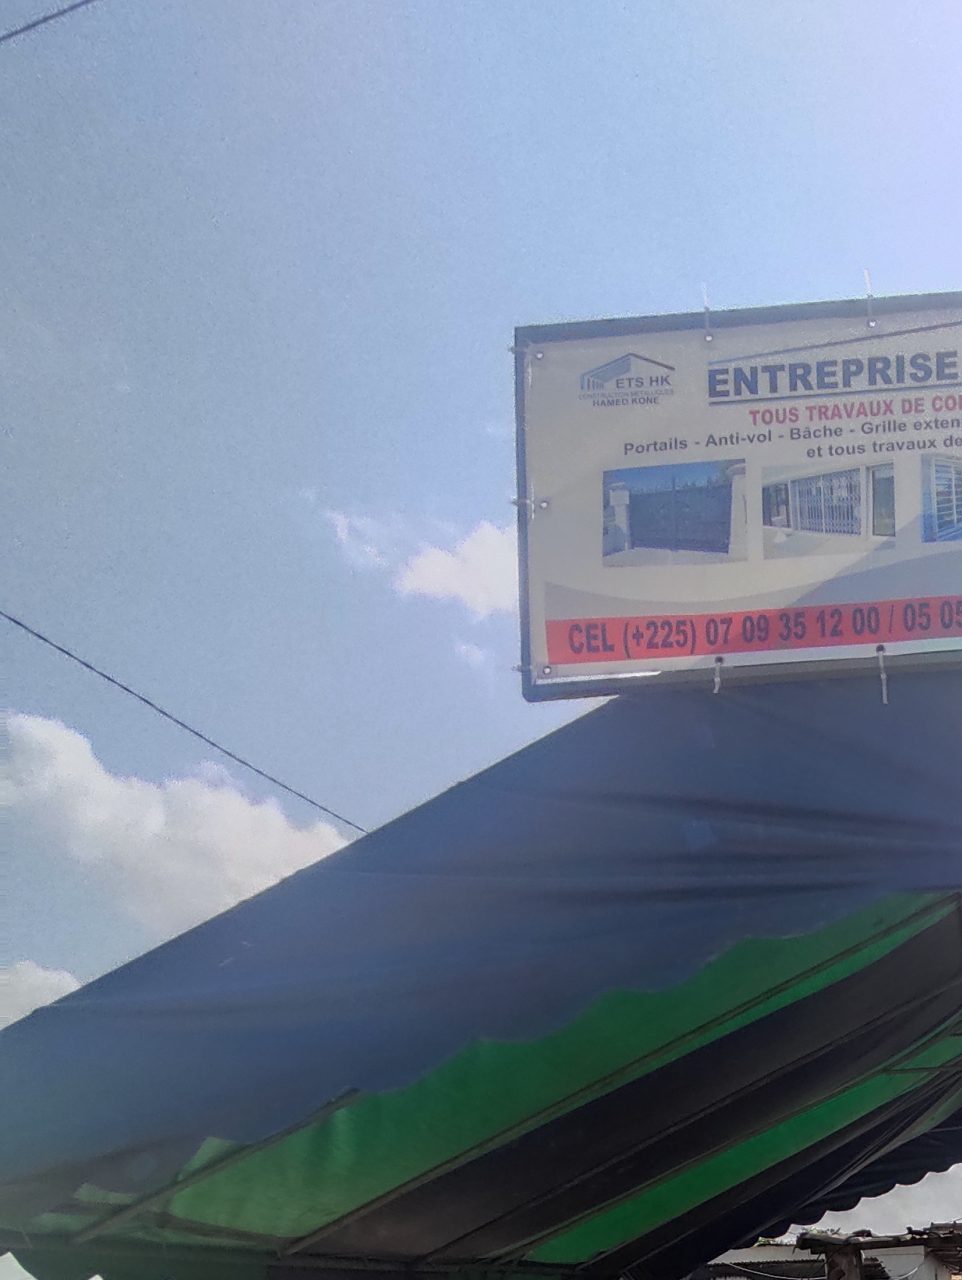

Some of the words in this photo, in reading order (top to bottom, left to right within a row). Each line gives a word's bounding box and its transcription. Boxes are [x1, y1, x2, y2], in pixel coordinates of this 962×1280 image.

[616, 377, 645, 389] ETS
[649, 375, 672, 387] HK
[708, 350, 959, 398] ENTREPRISE
[593, 398, 629, 406] HAMED
[631, 396, 660, 405] KONE
[749, 407, 799, 426] TOUS
[805, 399, 894, 422] TRAVAUX
[901, 396, 925, 415] DE
[623, 436, 688, 455] Portails
[705, 429, 772, 448] Anti-vol
[789, 425, 843, 441] Bâche
[861, 419, 907, 435] Grille
[806, 446, 823, 459] et
[828, 444, 866, 456] tous
[872, 438, 937, 453] travaux
[568, 623, 615, 654] CEL
[622, 619, 697, 659] (+225)
[705, 617, 732, 646] 07
[741, 614, 770, 643] 09
[778, 610, 806, 641] 35
[816, 608, 843, 638] 12
[852, 606, 880, 635] 00
[903, 602, 931, 632] 05
